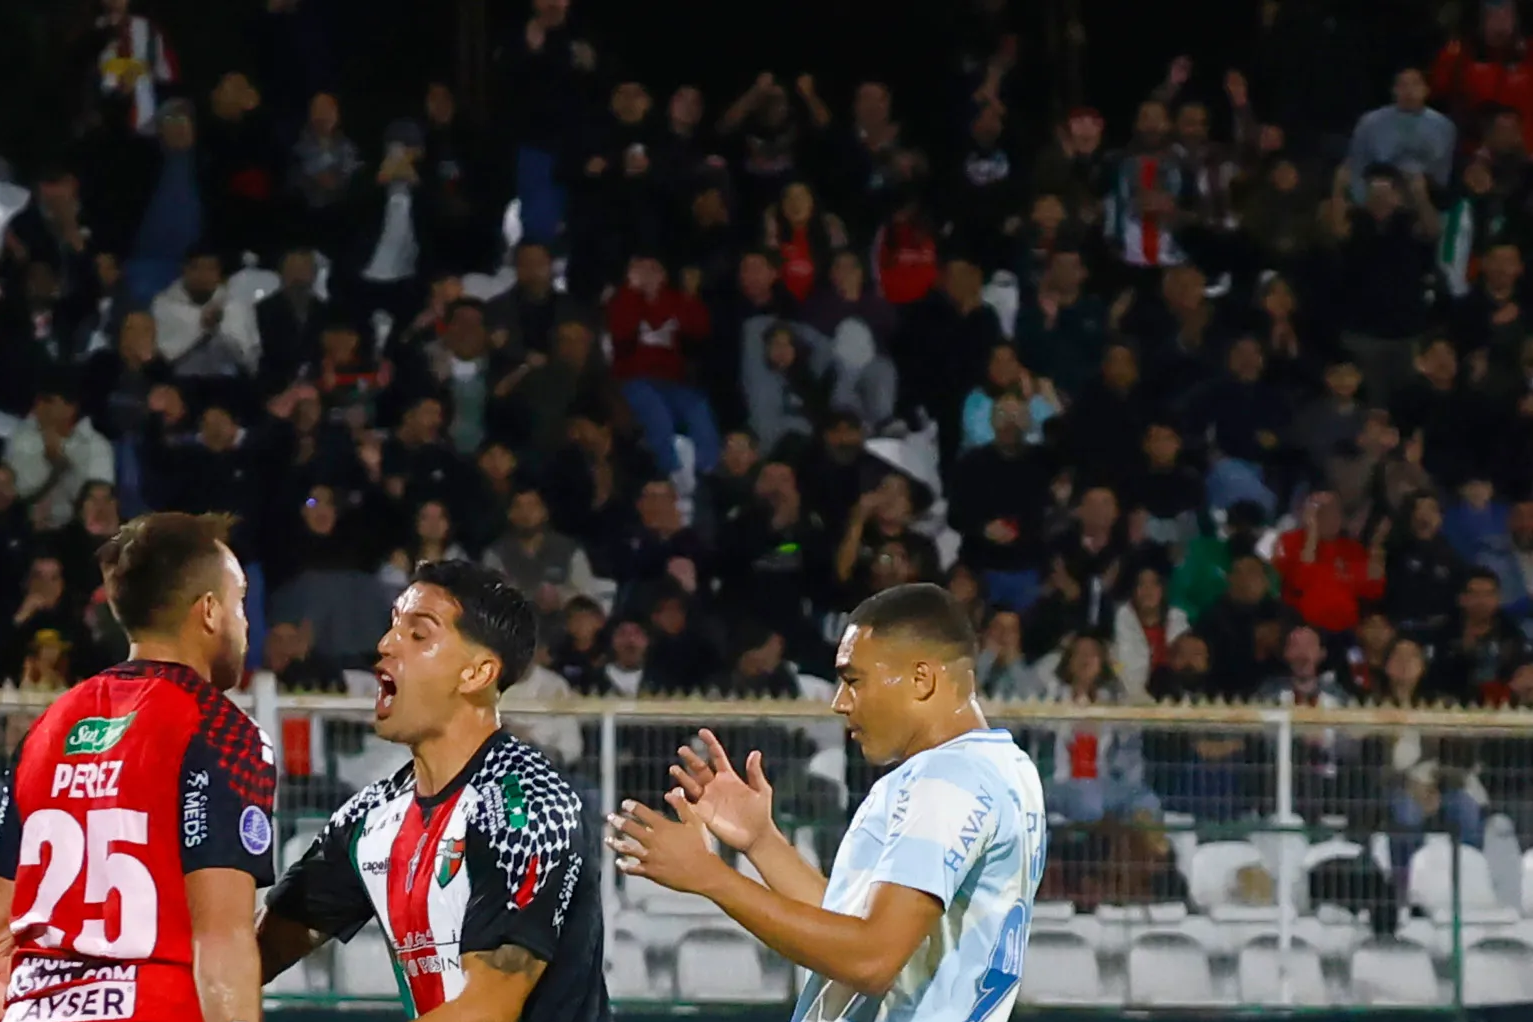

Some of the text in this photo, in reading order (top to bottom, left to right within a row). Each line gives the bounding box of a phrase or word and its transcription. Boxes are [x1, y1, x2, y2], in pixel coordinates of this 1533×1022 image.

[51, 760, 124, 799] PEREZ
[183, 790, 202, 848] MEDS
[943, 784, 994, 873] HAVAN
[10, 808, 158, 960] 25
[20, 986, 124, 1022] AYSER
